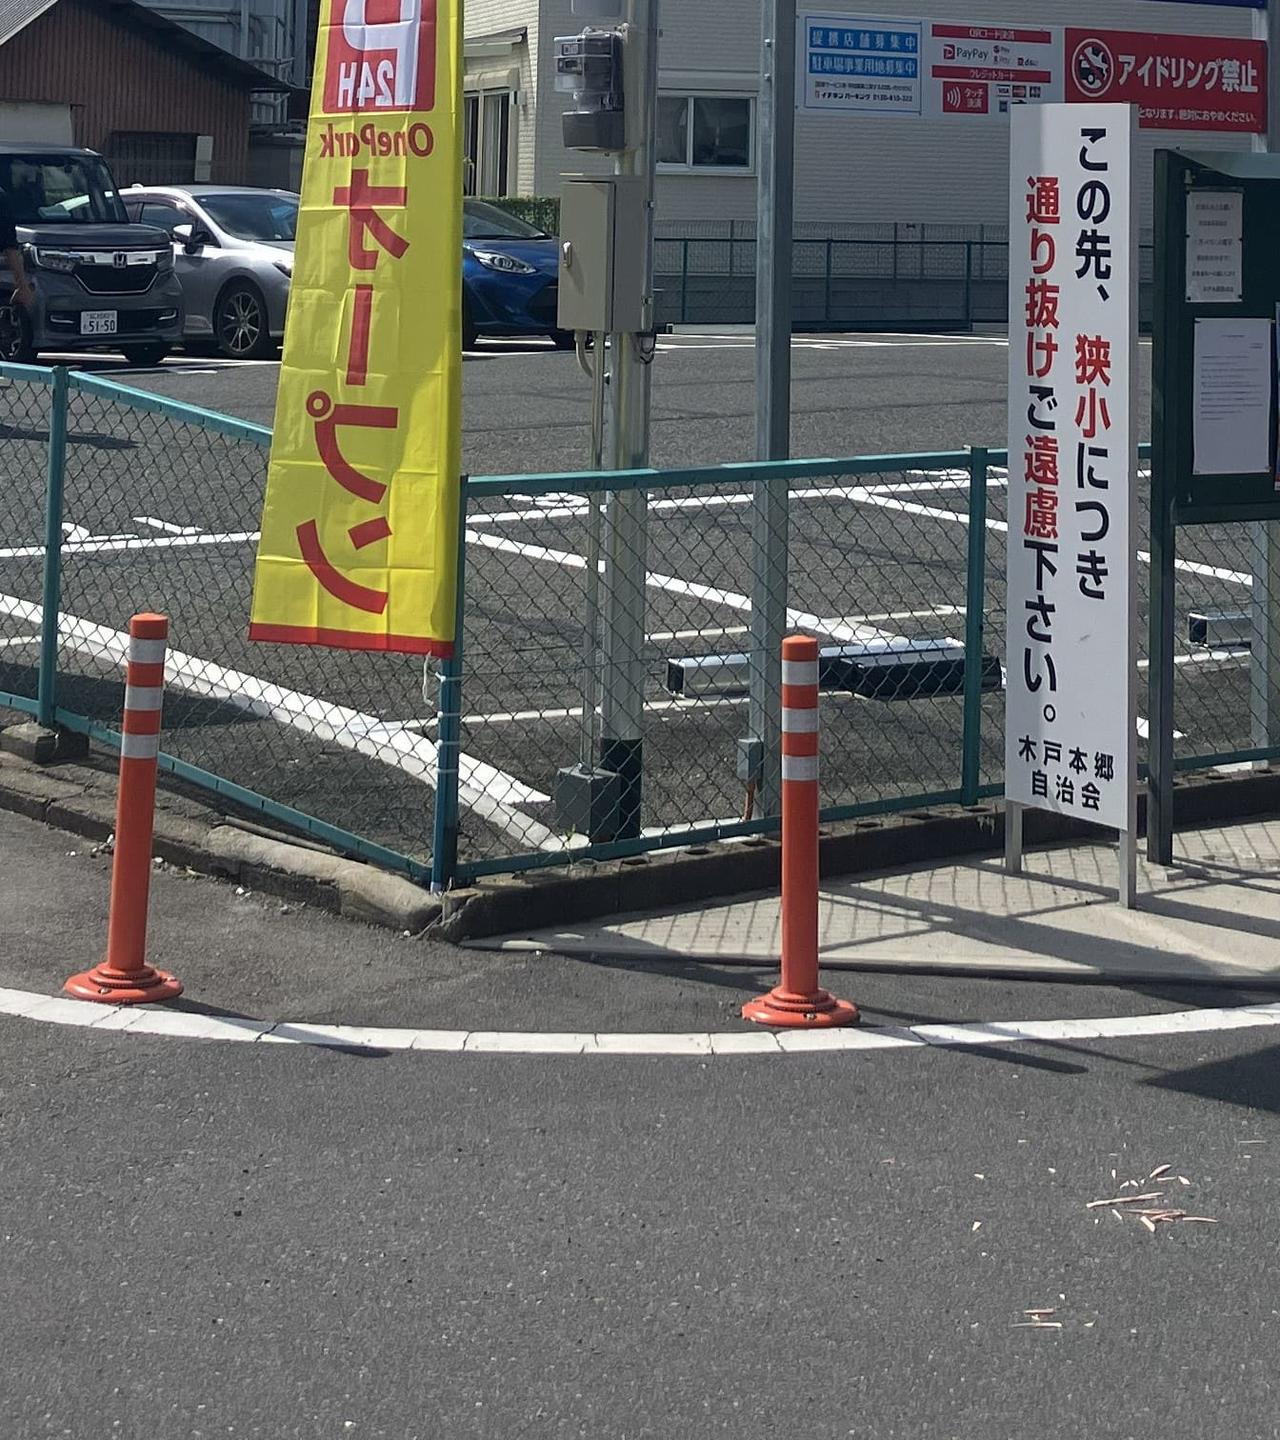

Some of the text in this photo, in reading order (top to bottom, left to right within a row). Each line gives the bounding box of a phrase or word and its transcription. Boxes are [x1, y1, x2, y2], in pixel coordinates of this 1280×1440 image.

[957, 47, 988, 61] PayPay
[1118, 54, 1258, 93] アイドリング禁止
[1023, 176, 1060, 723] 通り抜けご遠慮下さい。
[1019, 735, 1114, 782] 木戸本郷
[1032, 769, 1101, 811] 自治会
